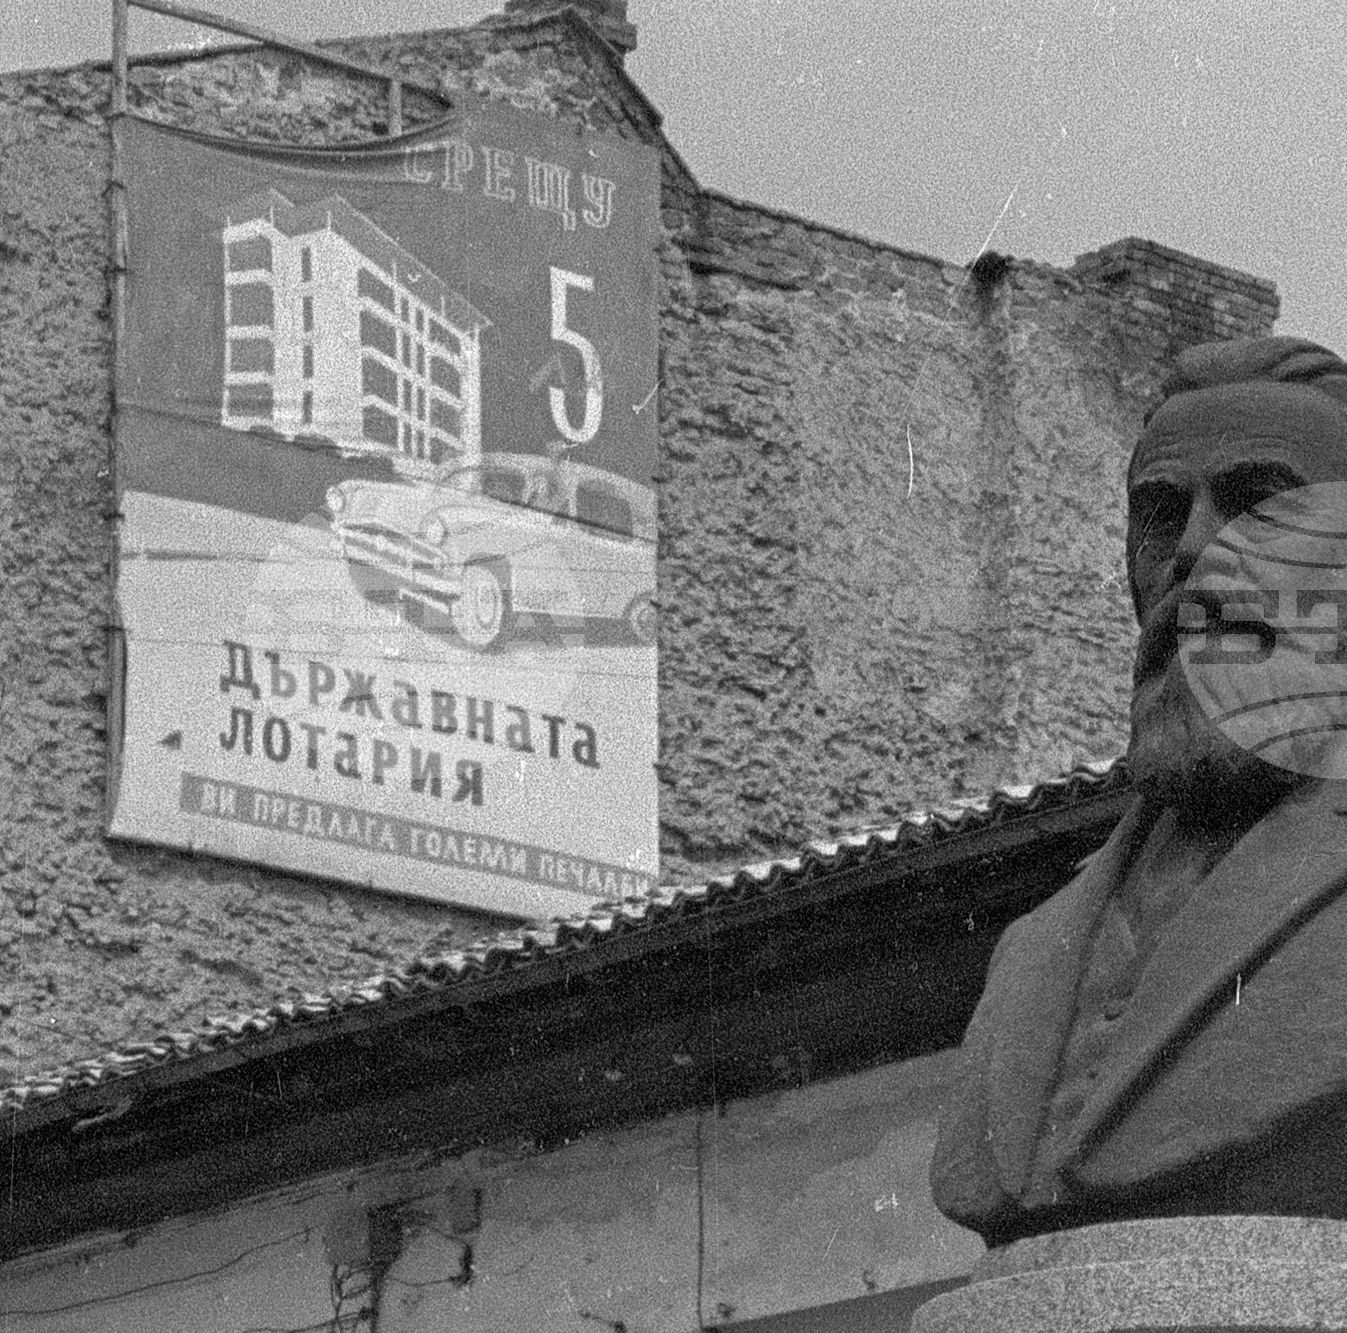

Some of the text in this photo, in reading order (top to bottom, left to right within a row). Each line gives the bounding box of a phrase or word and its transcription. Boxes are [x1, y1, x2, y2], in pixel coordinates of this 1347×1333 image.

[550, 266, 602, 444] 5
[202, 783, 236, 815] ВИ
[254, 792, 395, 851] ПРЕДЛАГА
